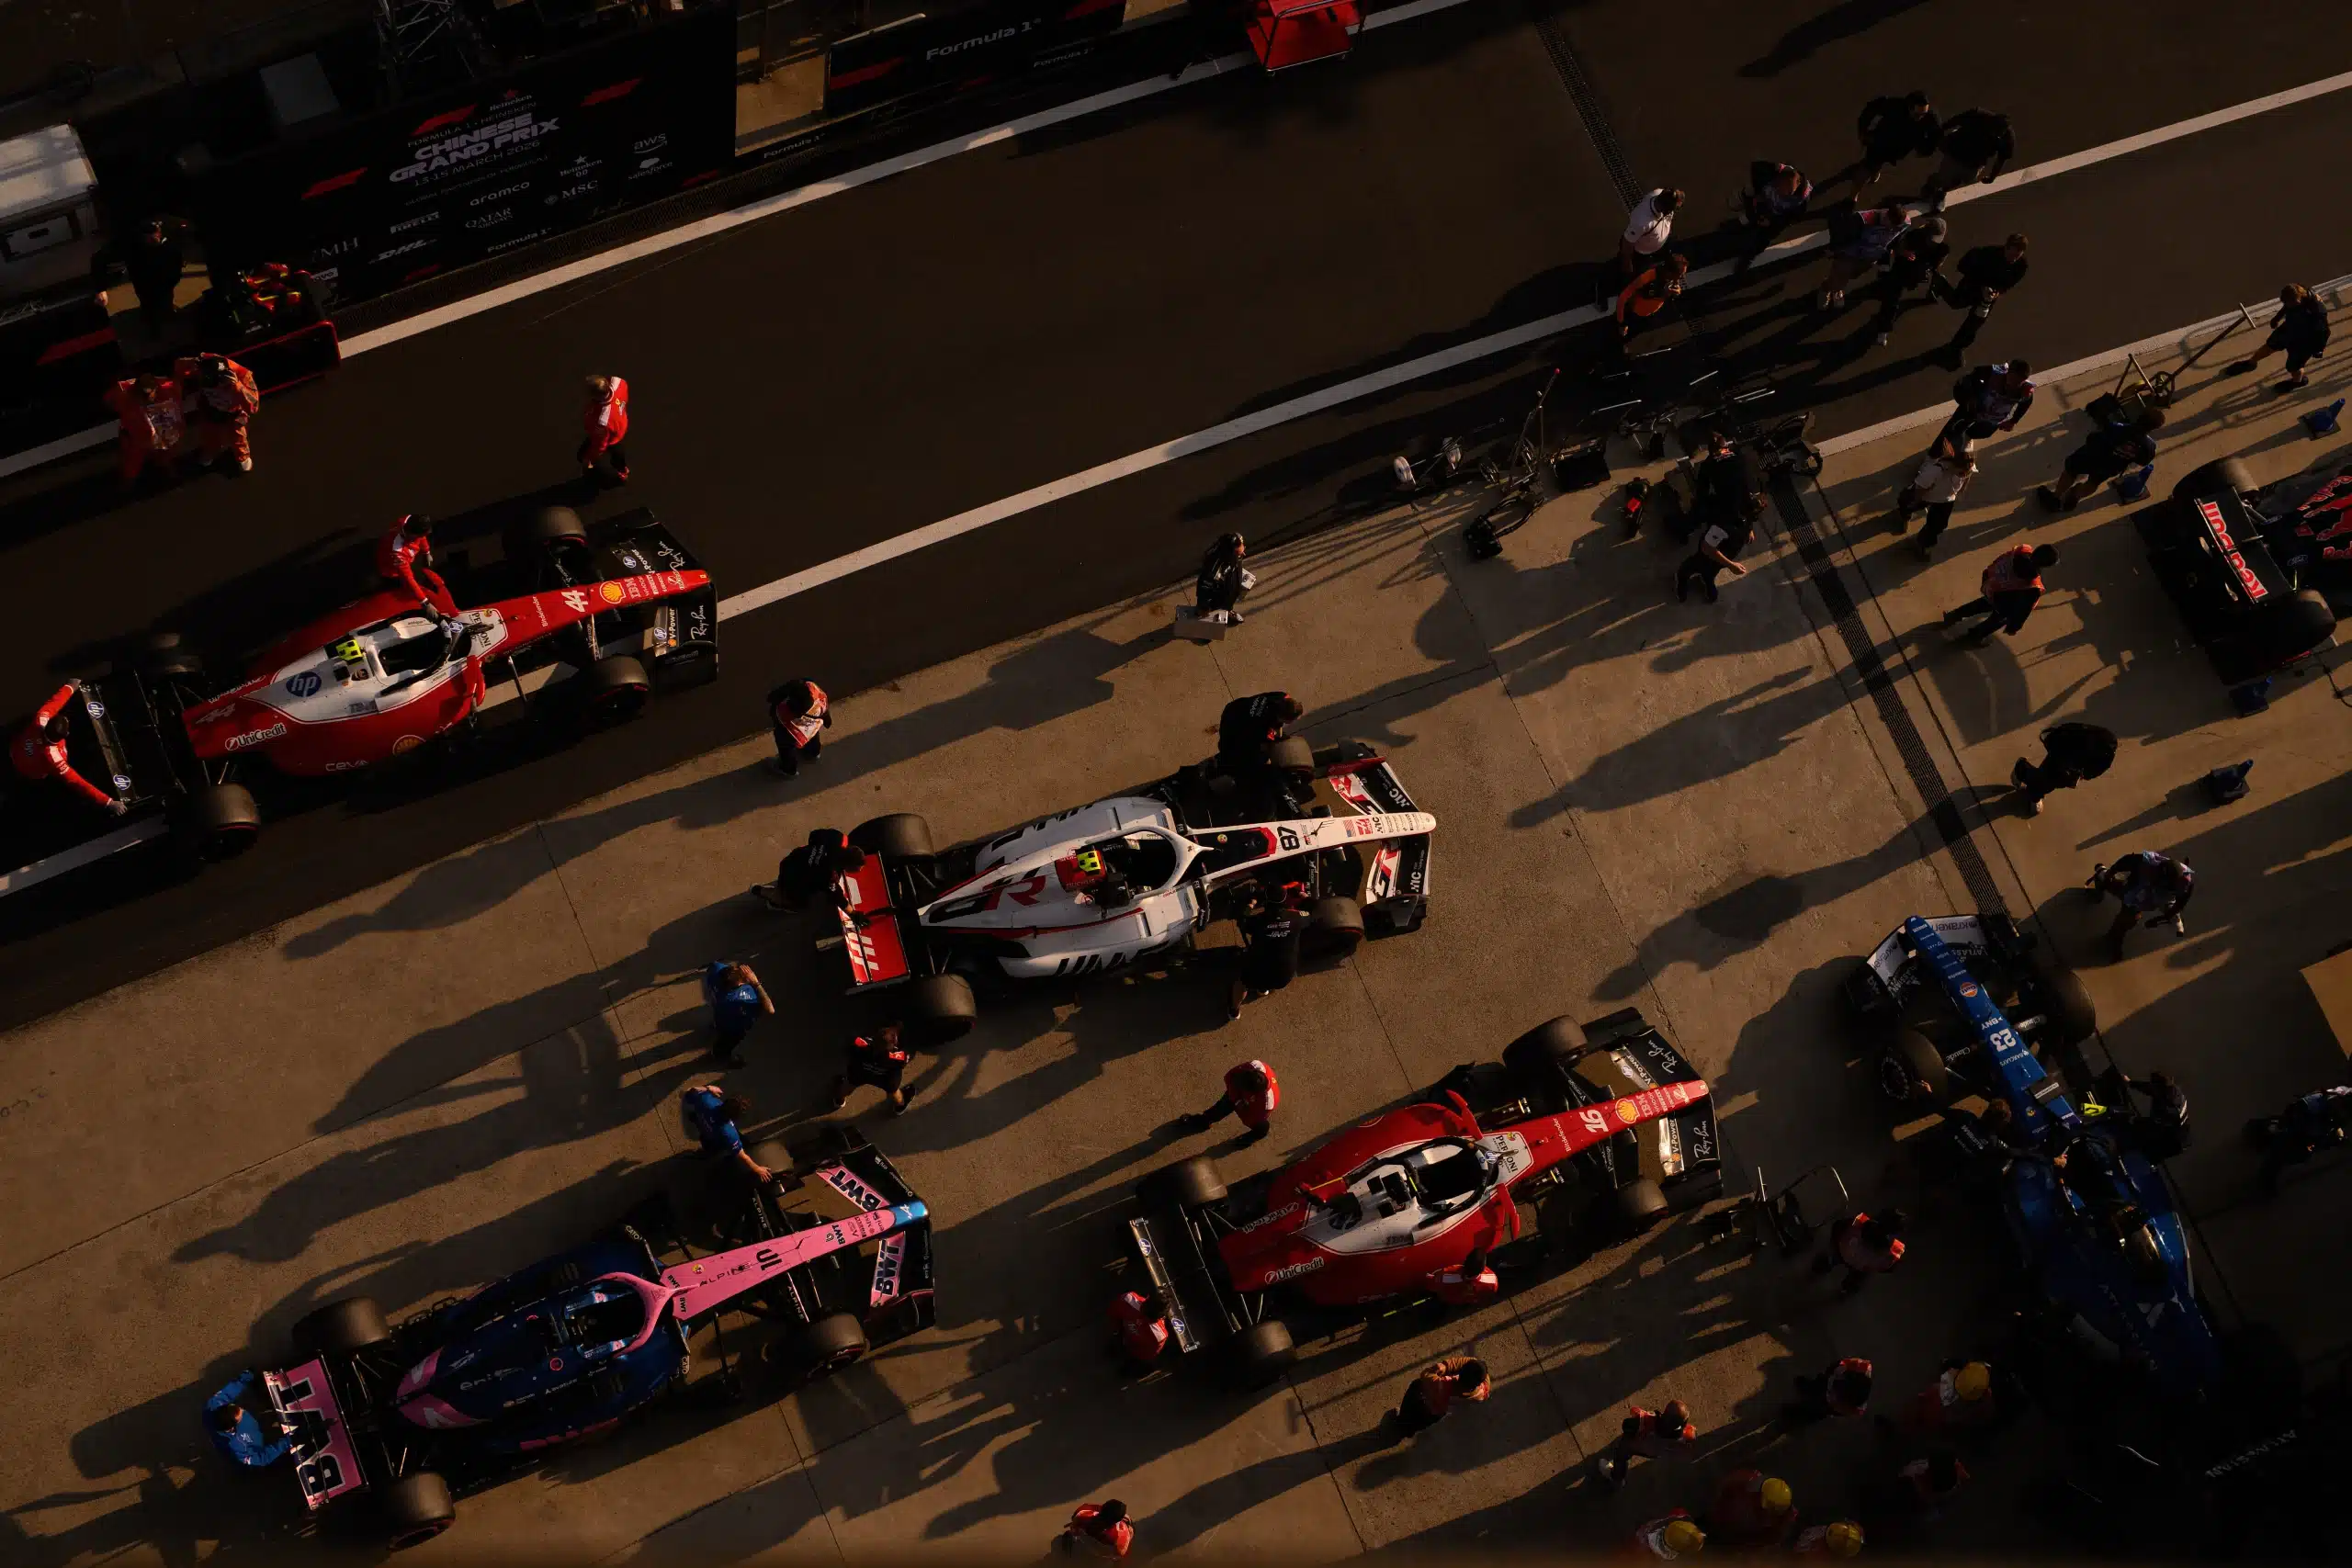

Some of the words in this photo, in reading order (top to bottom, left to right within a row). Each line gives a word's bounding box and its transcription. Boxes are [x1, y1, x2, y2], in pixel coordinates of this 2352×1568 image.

[926, 26, 1016, 61] Formula
[490, 93, 534, 111] Heineken
[414, 112, 533, 161] CHINESE
[634, 132, 667, 151] aws
[763, 139, 812, 159] Formula
[389, 141, 490, 183] GRAND
[494, 117, 560, 150] PRIX
[452, 152, 504, 175] MARCH
[506, 140, 541, 157] 2026
[559, 159, 604, 177] Heineken
[628, 161, 673, 181] salesforce
[469, 181, 530, 207] aramco
[561, 180, 598, 199] MSC
[464, 197, 511, 230] QATAR
[487, 233, 537, 254] Formula
[533, 595, 548, 627] Bitdefender
[561, 590, 589, 613] 44
[668, 607, 678, 640] V-Power
[292, 673, 319, 698] hp
[237, 722, 288, 748] UniCredit
[1276, 825, 1301, 852] 87
[1981, 1017, 1998, 1031] BNY
[2018, 1016, 2041, 1029] Claude
[1989, 1028, 2017, 1053] 23
[1646, 1039, 1679, 1074] Ray-Ban
[1944, 1046, 1971, 1063] Claude
[1999, 1052, 2024, 1067] BARCLAYS
[1626, 1055, 1652, 1086] V-Power
[1578, 1108, 1609, 1134] 16
[1552, 1117, 1572, 1153] Bitdefender
[1671, 1120, 1679, 1153] V-Power
[1693, 1120, 1712, 1160] Ray-Ban
[829, 1169, 882, 1211] BWT
[752, 1196, 767, 1231] ALPINE
[831, 1224, 846, 1246] BWT
[756, 1248, 783, 1271] 10
[874, 1238, 903, 1296] BWT
[1277, 1258, 1325, 1280] UniCredit
[699, 1261, 752, 1287] ALPINE
[786, 1285, 805, 1321] ALPINE
[269, 1378, 346, 1497] BWT
